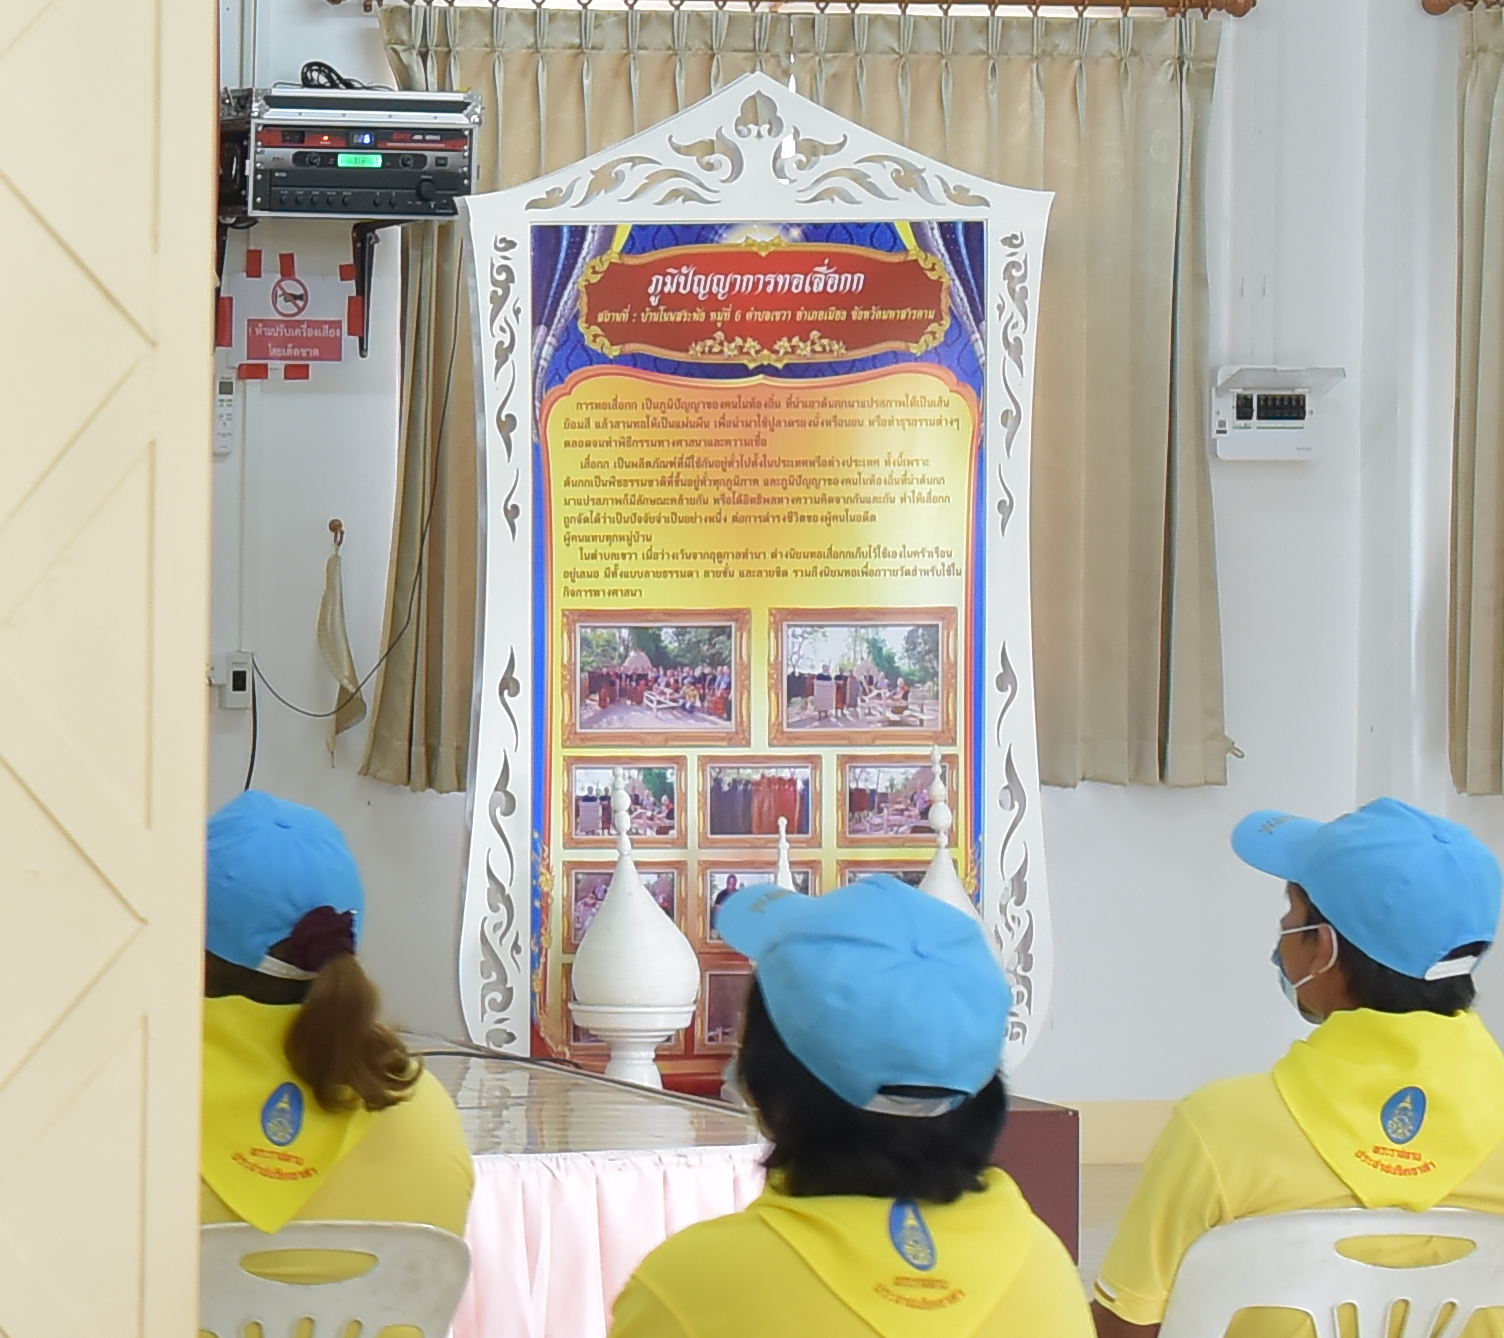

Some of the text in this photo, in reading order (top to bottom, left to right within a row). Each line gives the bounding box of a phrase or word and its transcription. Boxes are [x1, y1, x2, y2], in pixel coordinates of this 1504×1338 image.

[647, 258, 865, 305] ภูมิปัญญาการทอเสื่อกก
[254, 321, 341, 338] ห้ามปรับเครื่องเสียง
[267, 342, 320, 357] โดยเด็ดขาด
[576, 394, 638, 412] การทอเสื่อกก
